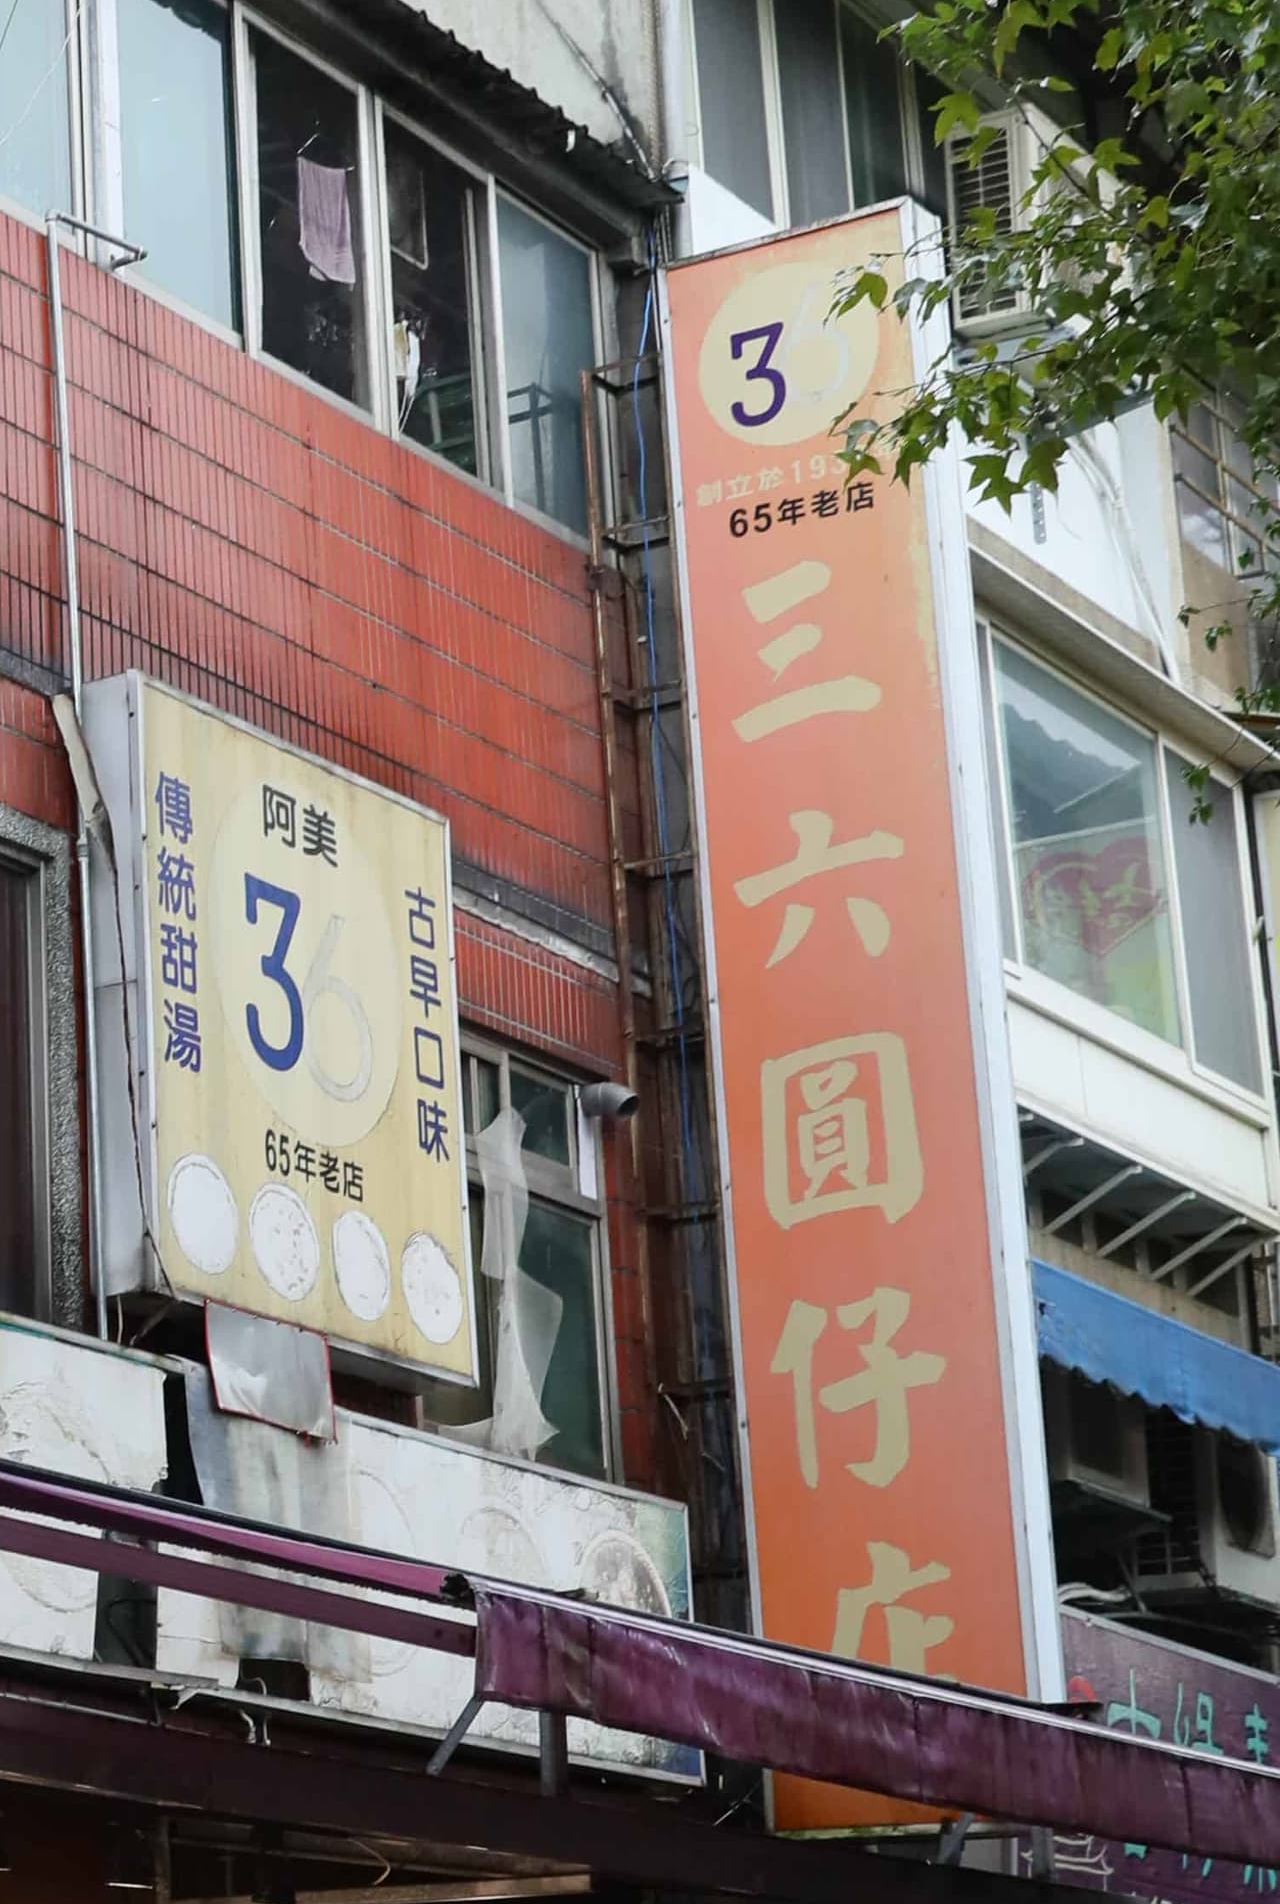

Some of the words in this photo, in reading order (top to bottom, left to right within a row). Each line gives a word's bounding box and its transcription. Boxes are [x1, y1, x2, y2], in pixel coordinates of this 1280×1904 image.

[729, 481, 874, 538] 65年老店
[260, 783, 339, 869] 阿美
[154, 770, 204, 1076] 傳統甜湯
[402, 883, 452, 1165] 古早口味
[264, 1126, 366, 1203] 65年老店
